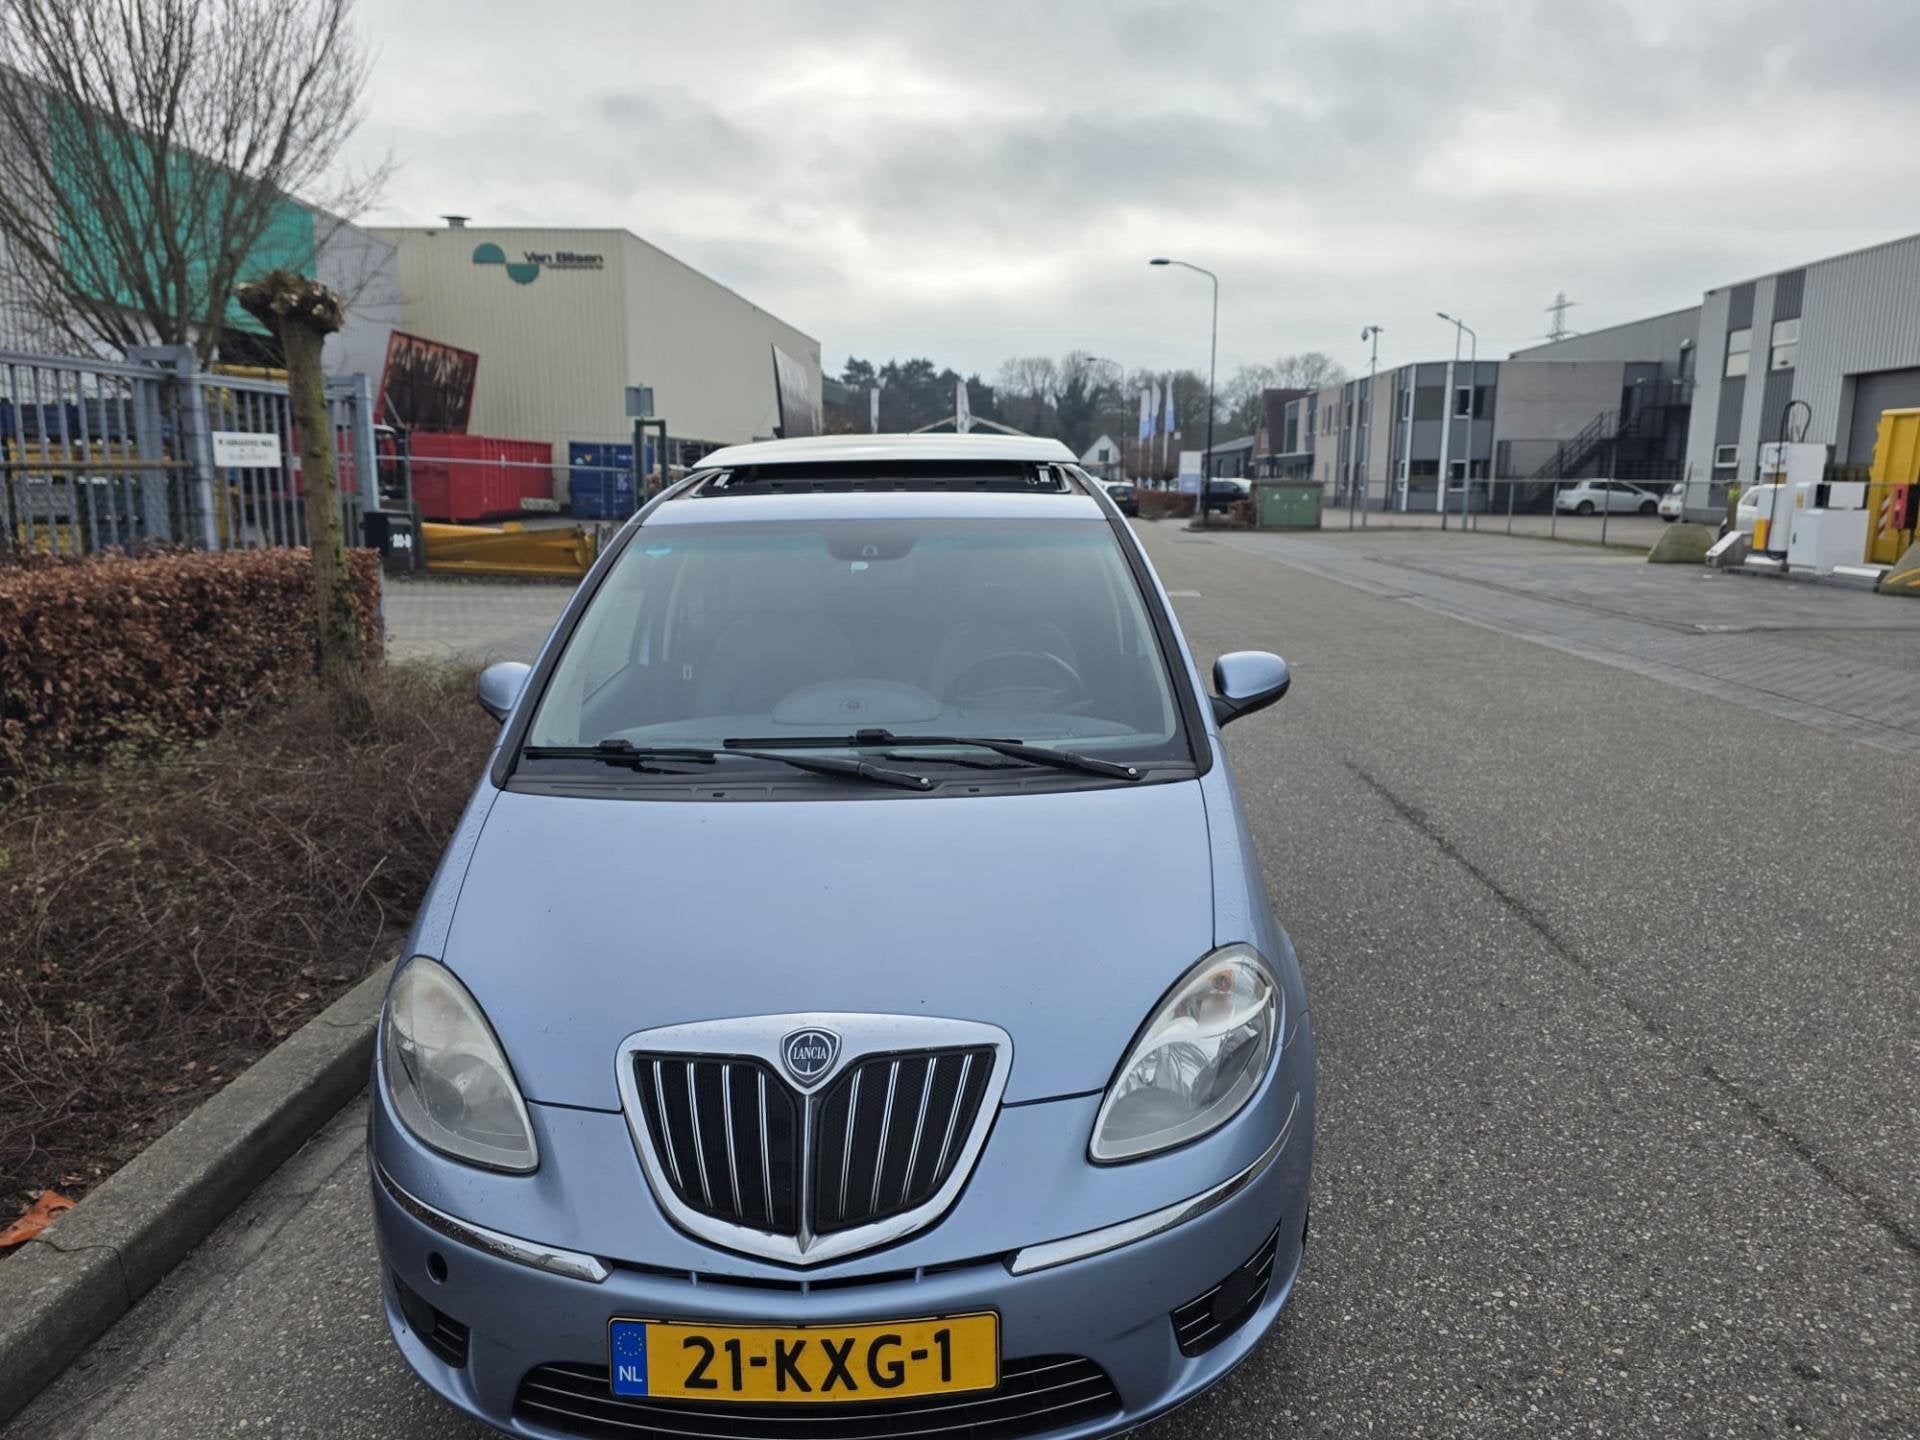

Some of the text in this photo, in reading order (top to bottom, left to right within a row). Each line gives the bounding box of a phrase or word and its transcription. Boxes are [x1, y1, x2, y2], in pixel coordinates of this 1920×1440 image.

[523, 251, 552, 263] Van
[792, 1046, 827, 1060] LANCIA
[683, 1328, 952, 1392] 21-KXG-1
[618, 1365, 643, 1383] NL
